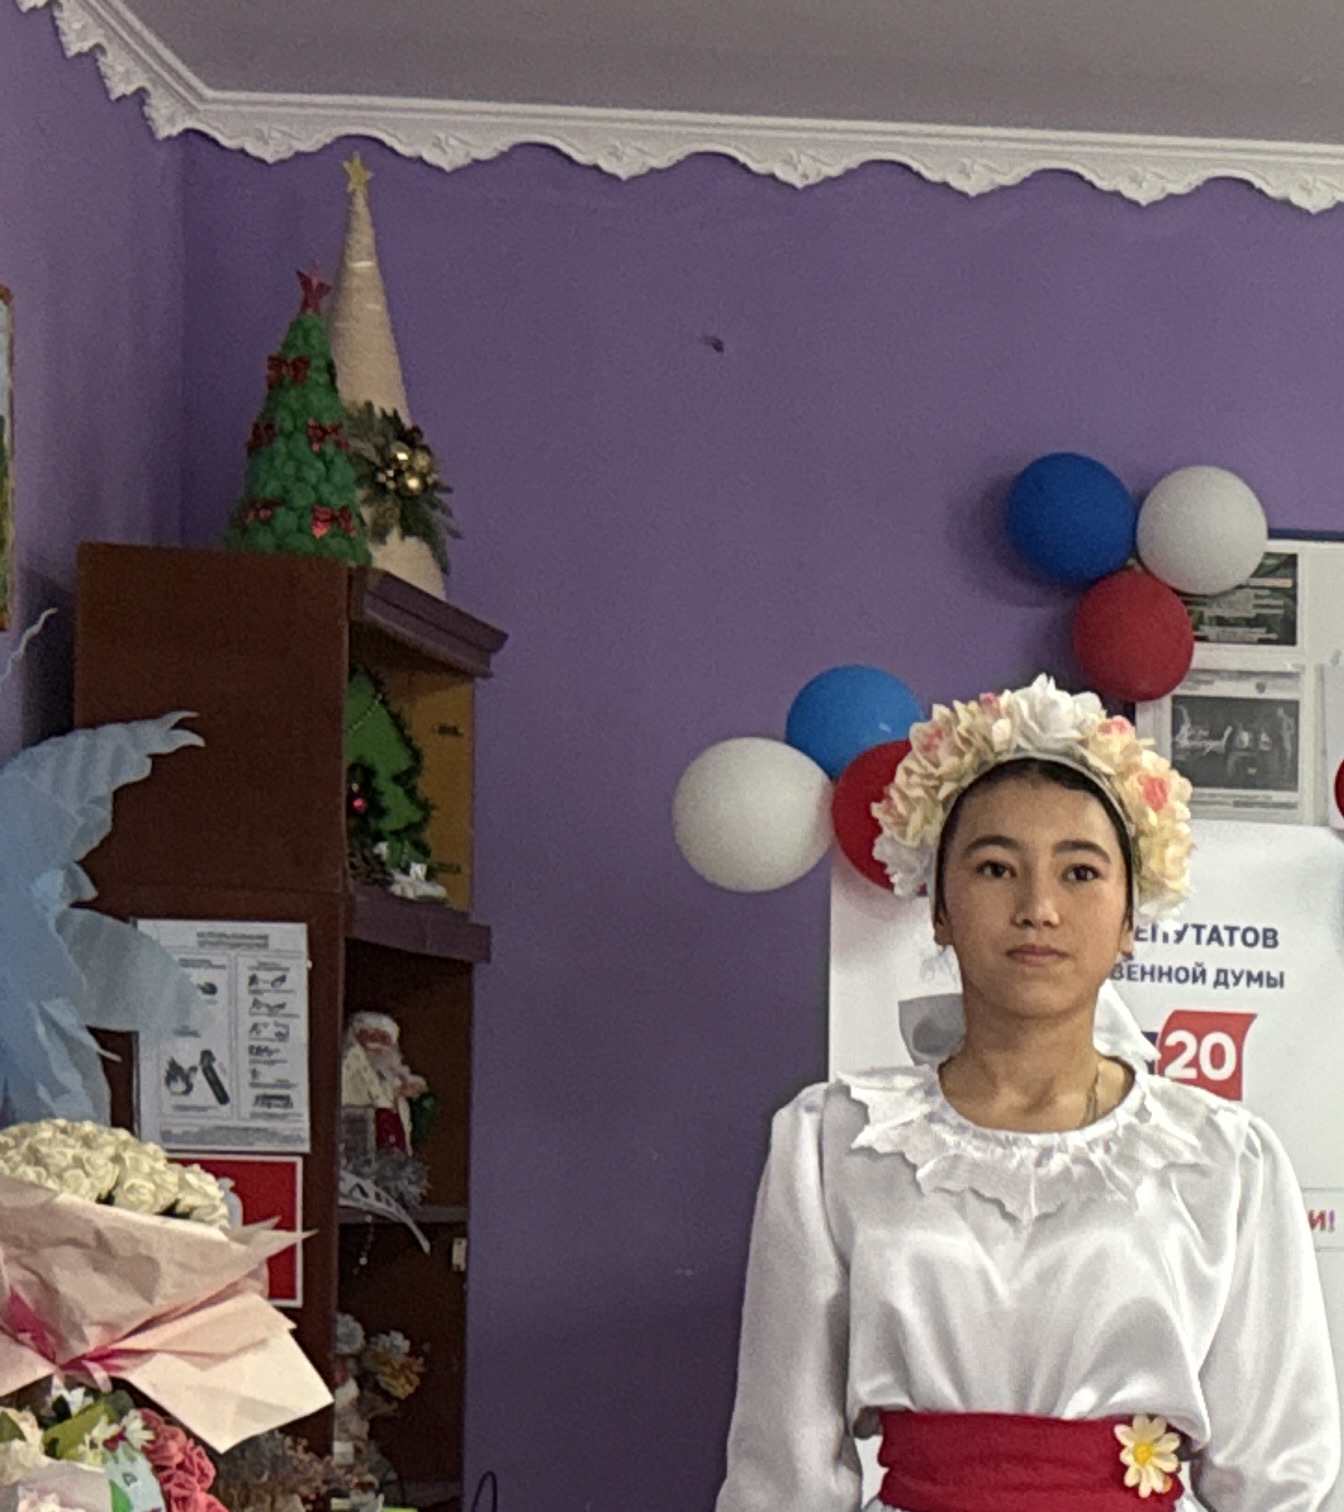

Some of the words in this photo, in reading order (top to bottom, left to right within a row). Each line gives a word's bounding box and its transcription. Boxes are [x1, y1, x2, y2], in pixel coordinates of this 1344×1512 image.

[1133, 922, 1280, 950] ЕПУТАТОВ
[1212, 967, 1286, 990] ДУМЫ
[1163, 1029, 1237, 1081] 20
